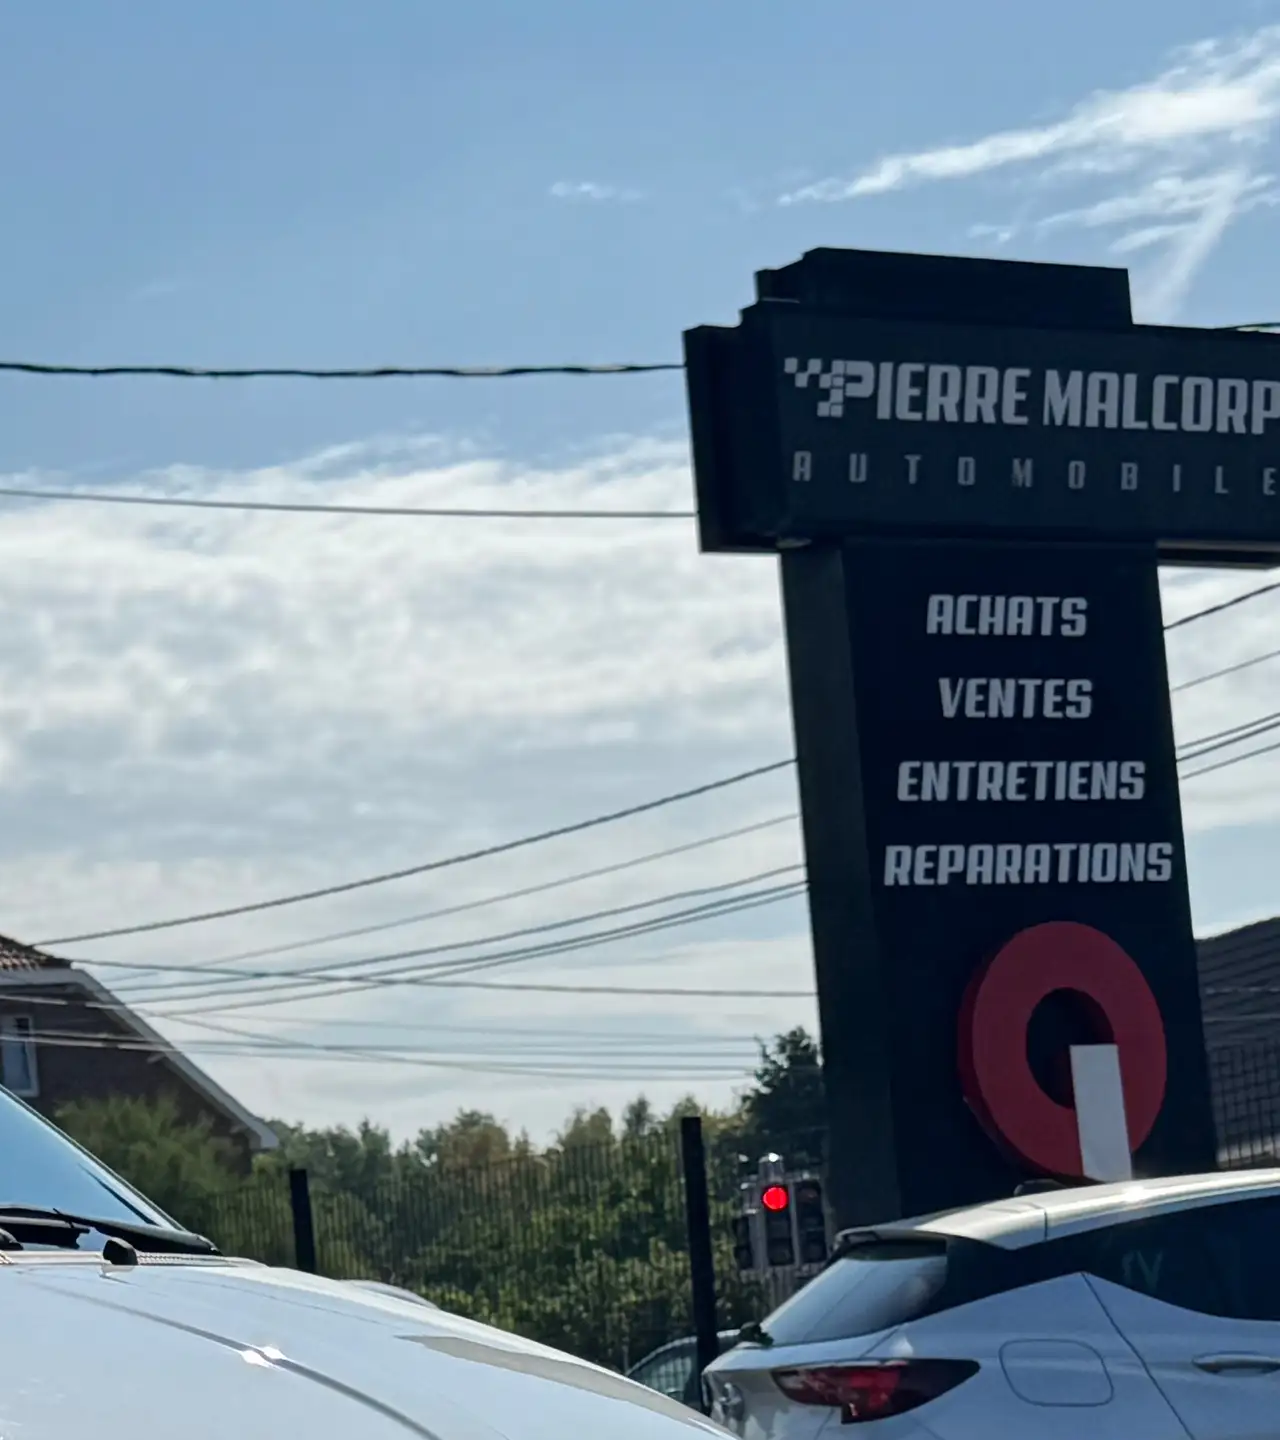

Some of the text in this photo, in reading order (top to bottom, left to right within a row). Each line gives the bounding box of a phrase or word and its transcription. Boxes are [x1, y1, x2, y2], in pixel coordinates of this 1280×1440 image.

[814, 358, 1031, 425] PIERRE
[793, 451, 1277, 495] AUTOMOBILE
[926, 594, 1088, 637] ACHATS
[939, 678, 1093, 719] VENTES
[897, 760, 1146, 802] ENTRETIENS
[884, 842, 1173, 886] REPARATIONS
